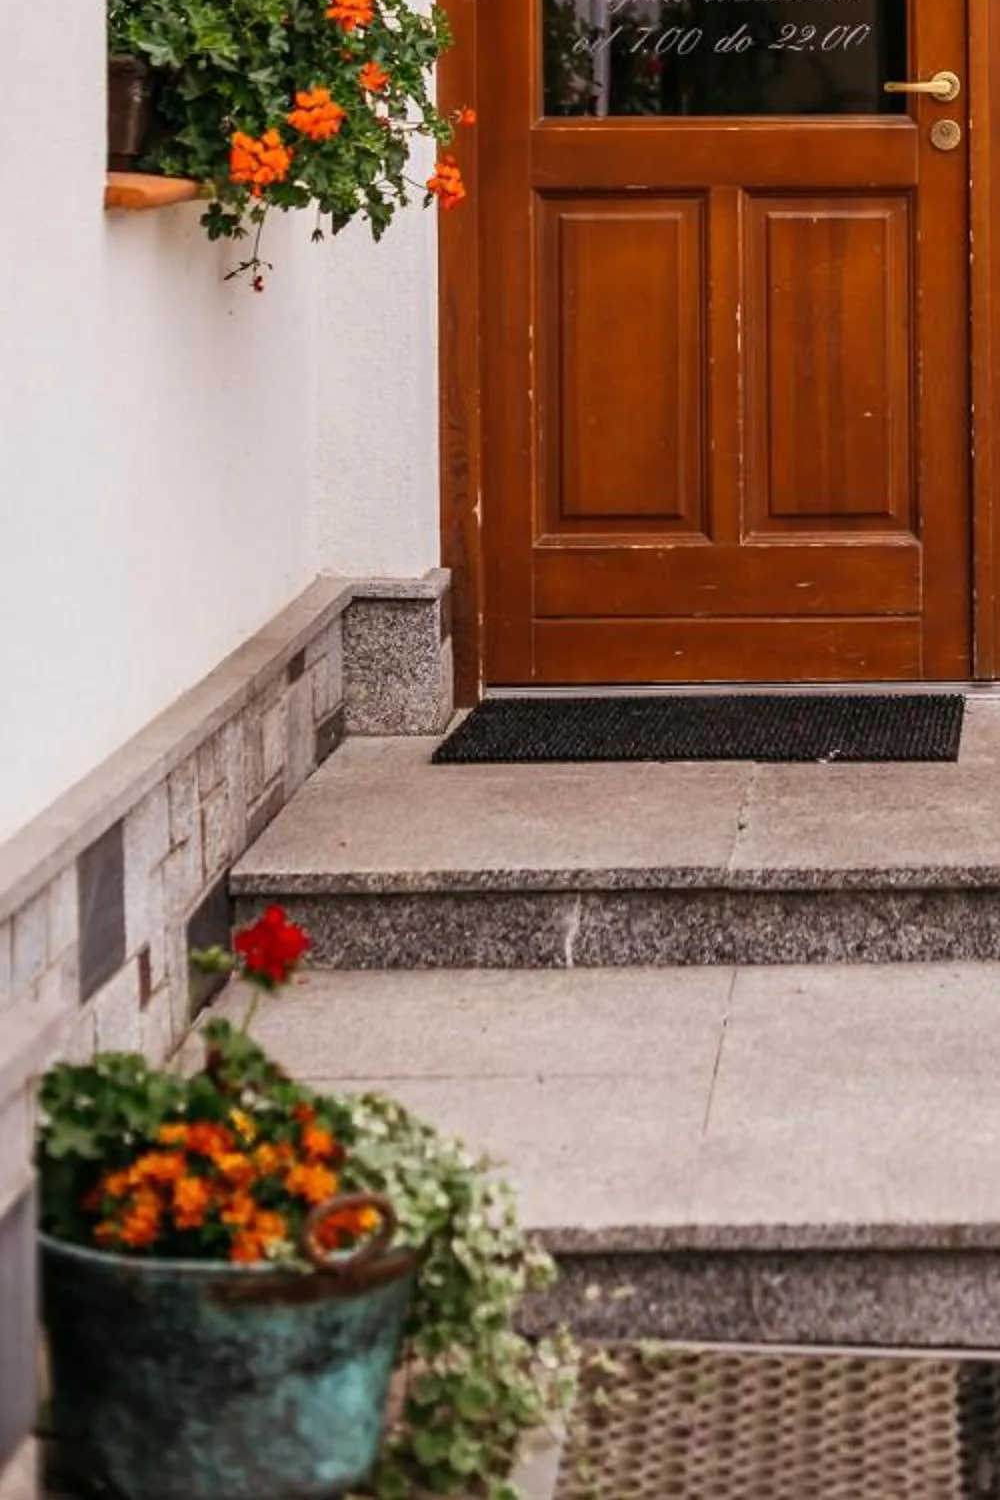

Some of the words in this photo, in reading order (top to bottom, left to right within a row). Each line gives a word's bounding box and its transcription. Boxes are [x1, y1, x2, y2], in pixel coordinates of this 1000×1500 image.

[571, 25, 624, 54] od
[630, 26, 703, 56] 7.00
[713, 23, 753, 53] do
[767, 23, 872, 52] 22.00
